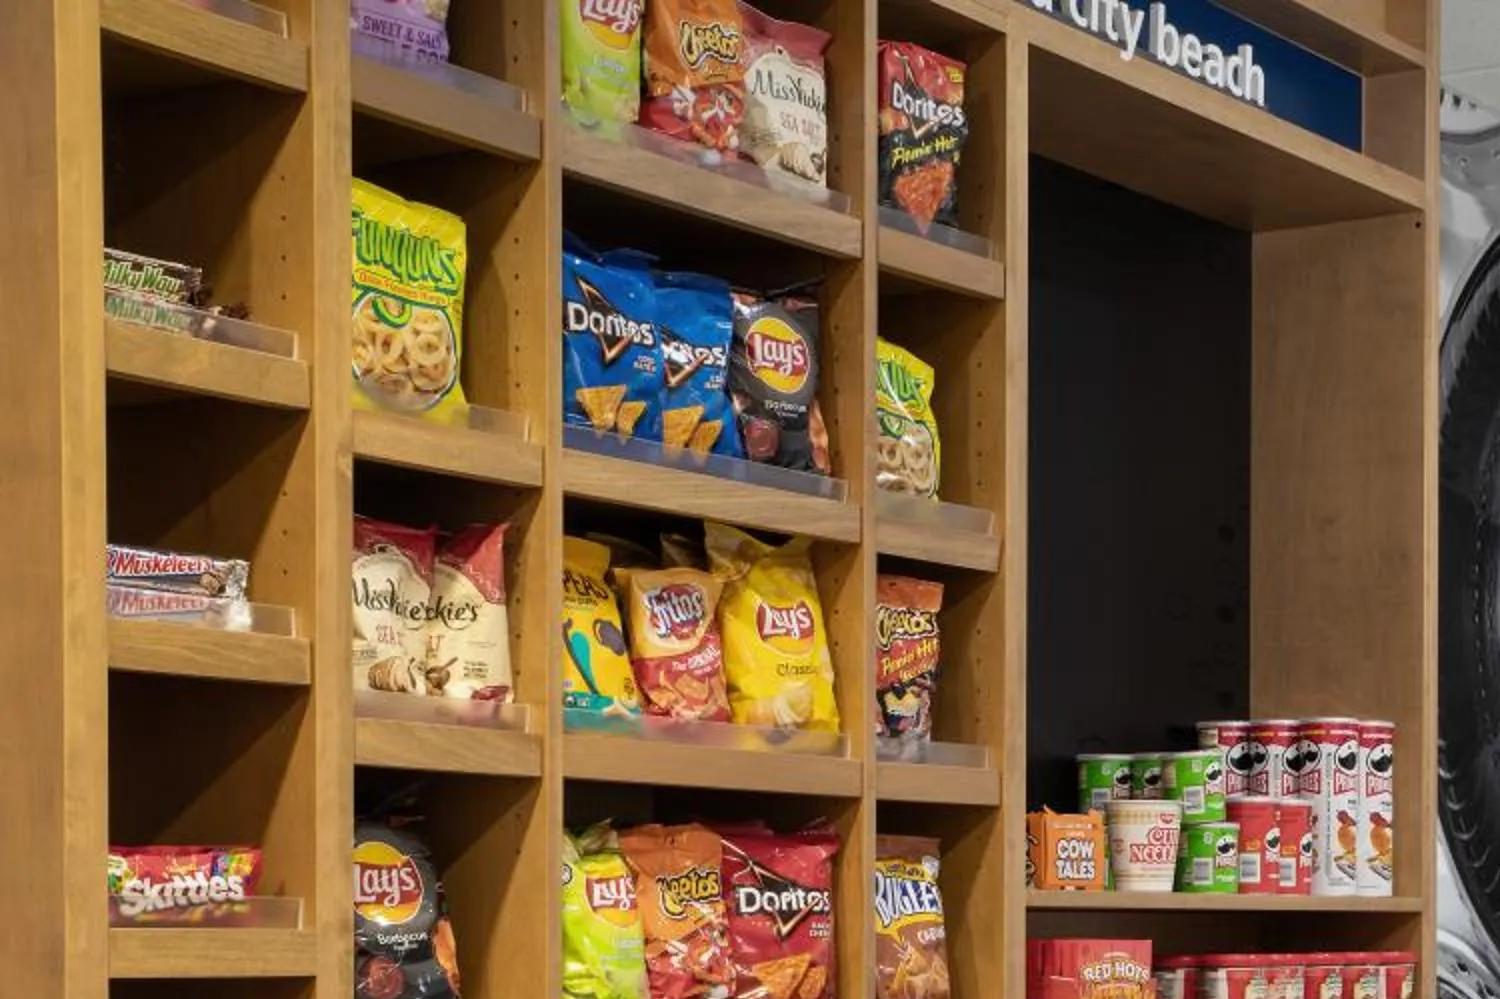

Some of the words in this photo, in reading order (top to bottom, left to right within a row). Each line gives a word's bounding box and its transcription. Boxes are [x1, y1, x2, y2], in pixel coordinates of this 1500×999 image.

[1154, 3, 1266, 107] beach
[892, 81, 966, 127] Doritos
[567, 301, 655, 346] Doritos
[750, 332, 807, 376] Lay's
[763, 600, 812, 640] Lay's
[1057, 839, 1095, 859] COW
[354, 865, 416, 906] Lay's
[1055, 859, 1096, 881] TALES
[119, 871, 245, 916] Skittles
[738, 885, 830, 914] Doritos
[1083, 963, 1111, 983] RED
[1114, 961, 1150, 980] HOTS
